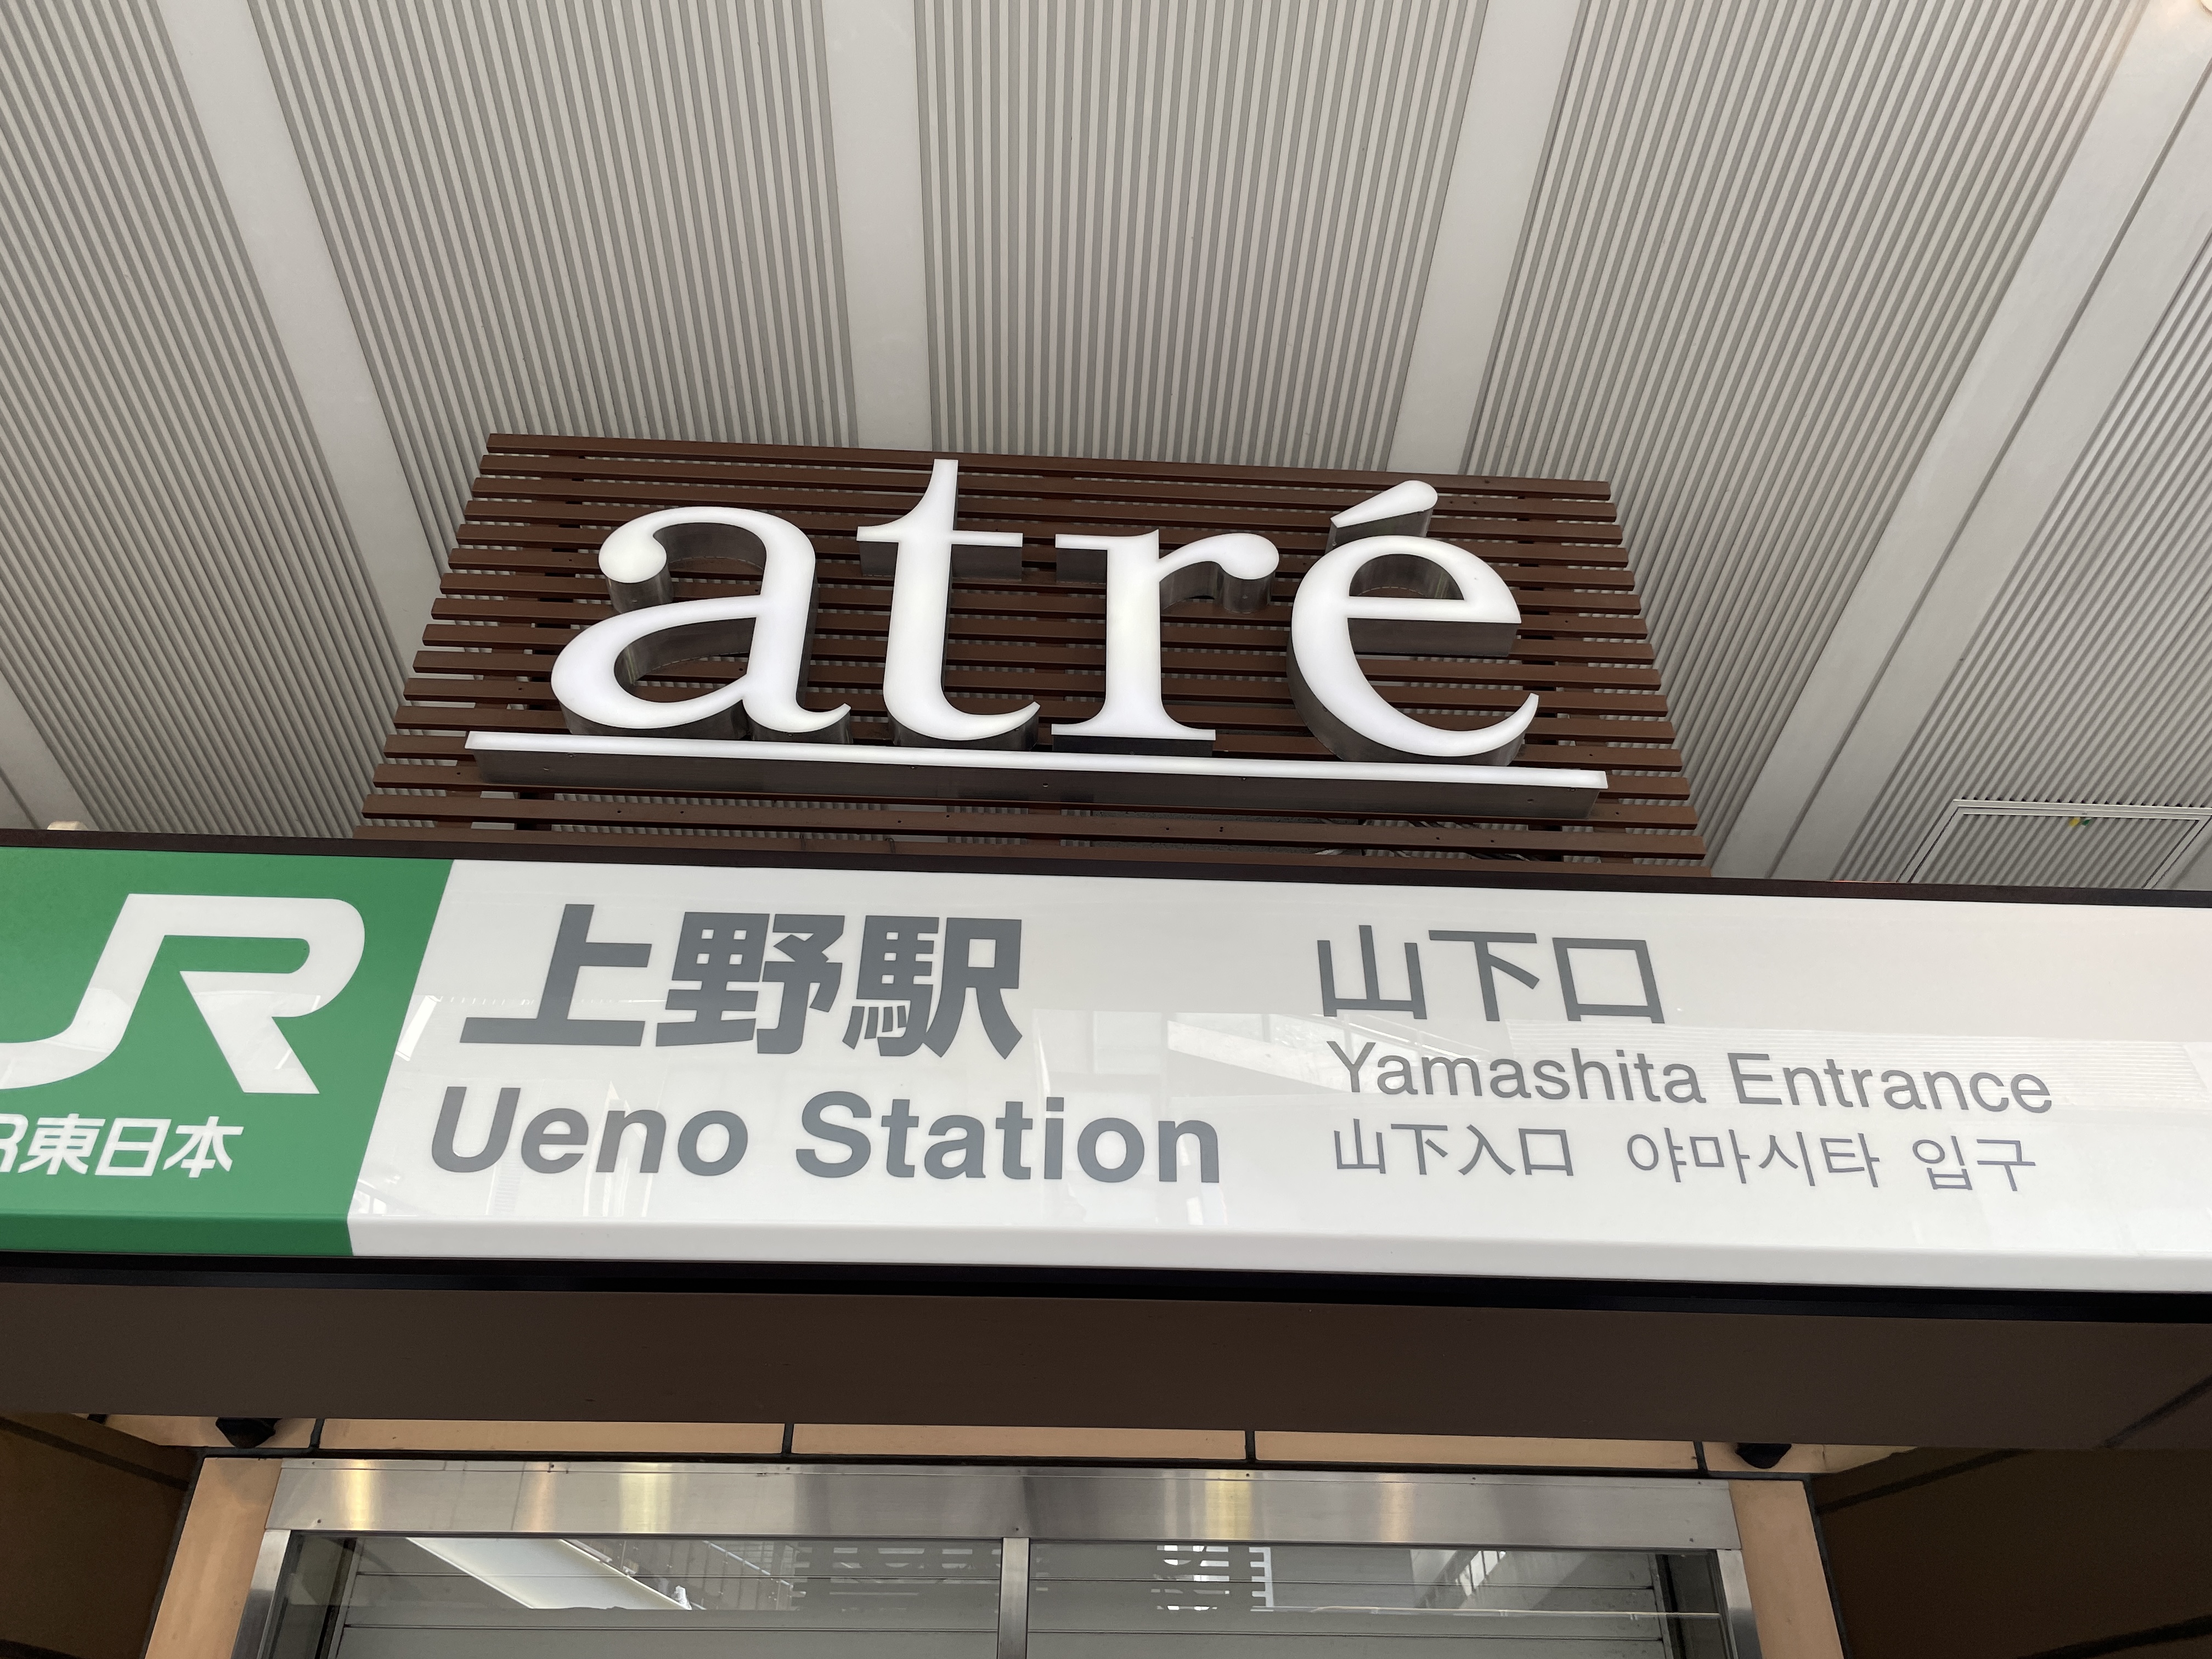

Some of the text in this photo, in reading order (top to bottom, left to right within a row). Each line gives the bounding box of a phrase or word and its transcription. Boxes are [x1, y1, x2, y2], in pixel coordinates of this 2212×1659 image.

[550, 458, 1540, 757] atré
[0, 893, 365, 1095] JR
[459, 904, 1023, 1060] 上野駅
[1317, 924, 1666, 1024] 山下口
[1326, 1041, 2052, 1114] Yamashita Entrance
[431, 1086, 1220, 1184] Ueno Station
[1334, 1118, 1574, 1177] 山下入口
[1627, 1127, 2036, 1192] 야마시타 입구
